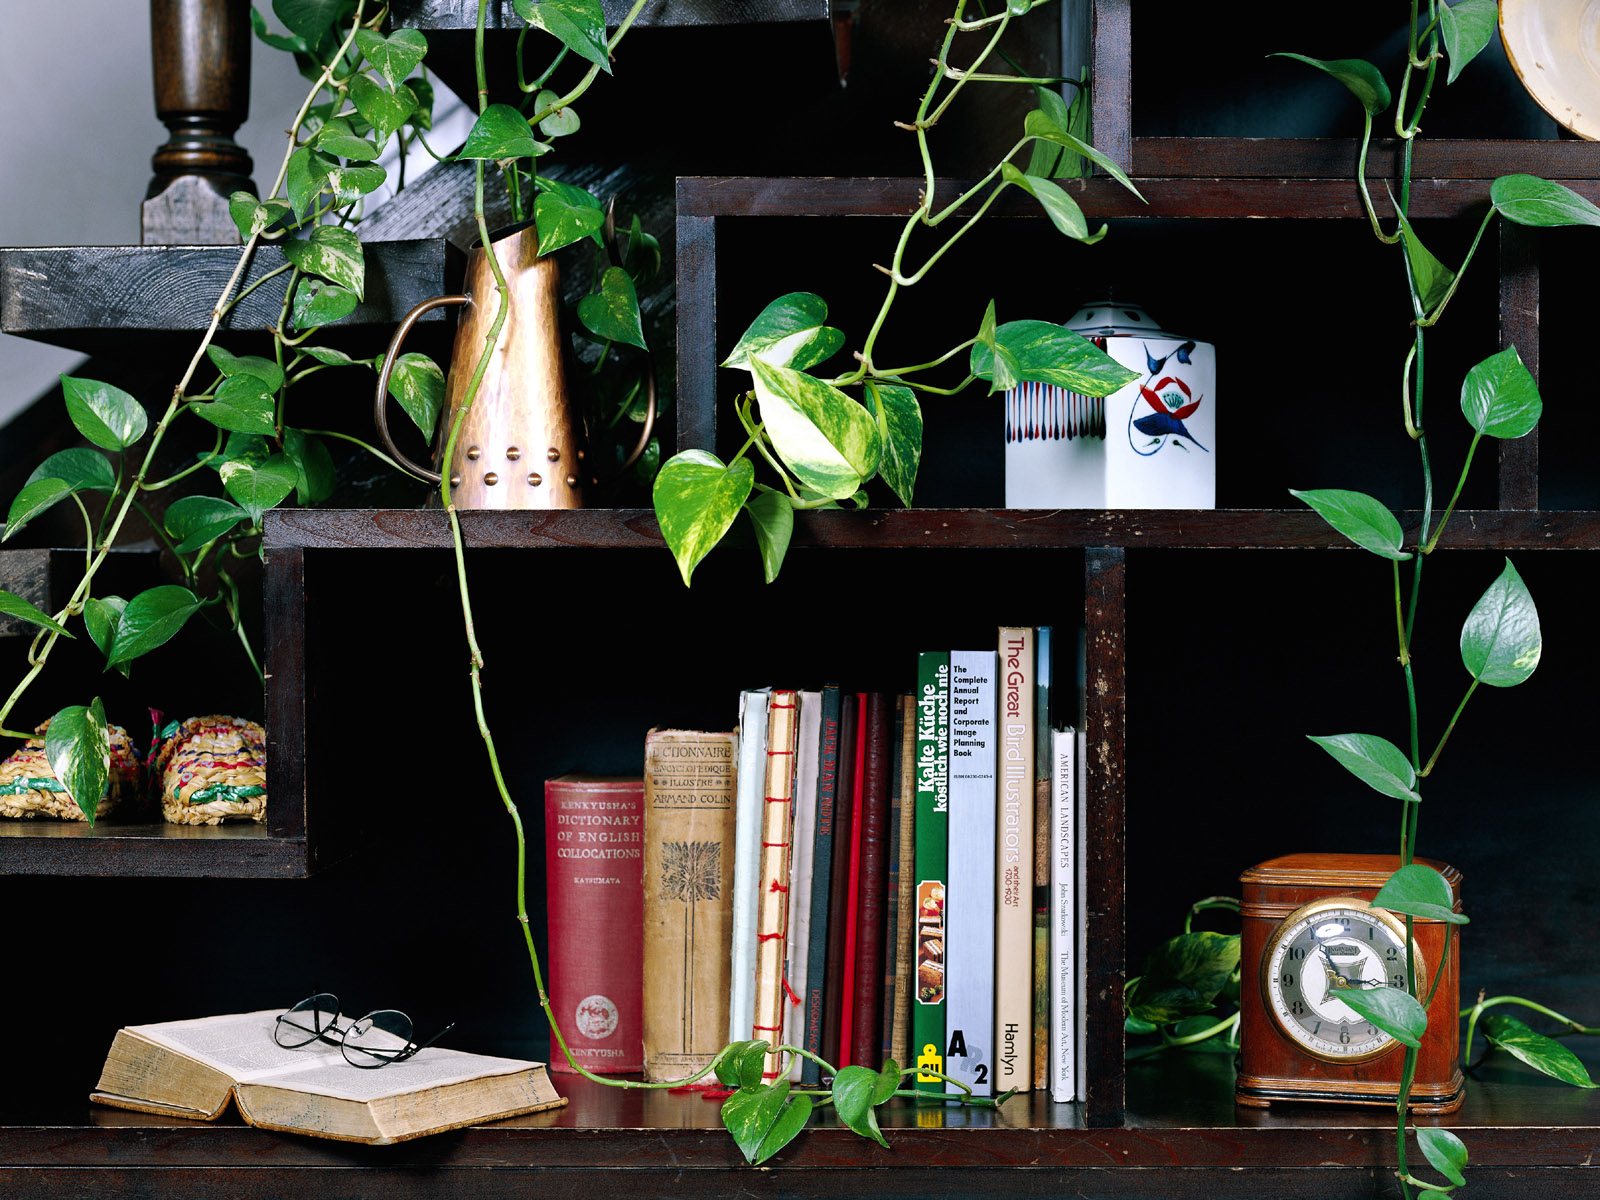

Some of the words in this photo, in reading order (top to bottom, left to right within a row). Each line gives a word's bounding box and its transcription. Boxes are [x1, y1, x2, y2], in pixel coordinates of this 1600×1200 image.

[1007, 637, 1024, 668] The
[934, 664, 948, 688] nie
[953, 665, 967, 673] The
[953, 676, 988, 685] Complete
[953, 686, 979, 694] Annual
[1006, 671, 1024, 718] Great
[933, 689, 948, 726] noch
[953, 697, 979, 706] Report
[918, 683, 936, 741] Küche
[953, 707, 968, 715] and
[953, 718, 990, 727] Corporate
[824, 717, 837, 758] JACK
[934, 727, 948, 754] wie
[953, 729, 977, 737] Image
[953, 739, 985, 749] Planning
[1005, 723, 1026, 761] Bird
[652, 746, 731, 758] DCTIONNAIRE
[953, 749, 972, 757] Book
[822, 759, 836, 792] MAN
[918, 744, 935, 793] Kalte
[933, 755, 948, 812] köstlich
[1060, 753, 1069, 803] AMERICAN
[560, 801, 637, 811] KENKYUSHA'S
[700, 795, 731, 804] COLIN
[558, 815, 640, 826] DICTIONARY
[819, 796, 833, 835] NOTE
[1005, 766, 1025, 863] Illustrators
[557, 831, 573, 842] OF
[578, 832, 640, 842] ENGLISH
[1060, 807, 1069, 869] LANDSCAPES
[557, 848, 640, 859] COLLOCATIONS
[1004, 868, 1013, 905] 1730-1930
[1059, 882, 1068, 898] John
[1061, 951, 1069, 966] The
[1289, 947, 1305, 961] 10
[1386, 948, 1397, 961] 2
[1061, 966, 1069, 996] Museum
[1283, 974, 1294, 987] 9
[1393, 974, 1405, 988] 3
[1061, 996, 1069, 1004] of
[1292, 1001, 1304, 1015] 8
[1061, 1004, 1069, 1031] Modern
[1312, 1021, 1322, 1034] 7
[569, 1048, 625, 1057] KENKYUSHA
[947, 1030, 968, 1057] A
[974, 1064, 988, 1084] 2
[1000, 1023, 1018, 1076] Hamlyn
[1061, 1048, 1069, 1064] New
[1061, 1065, 1069, 1081] York
